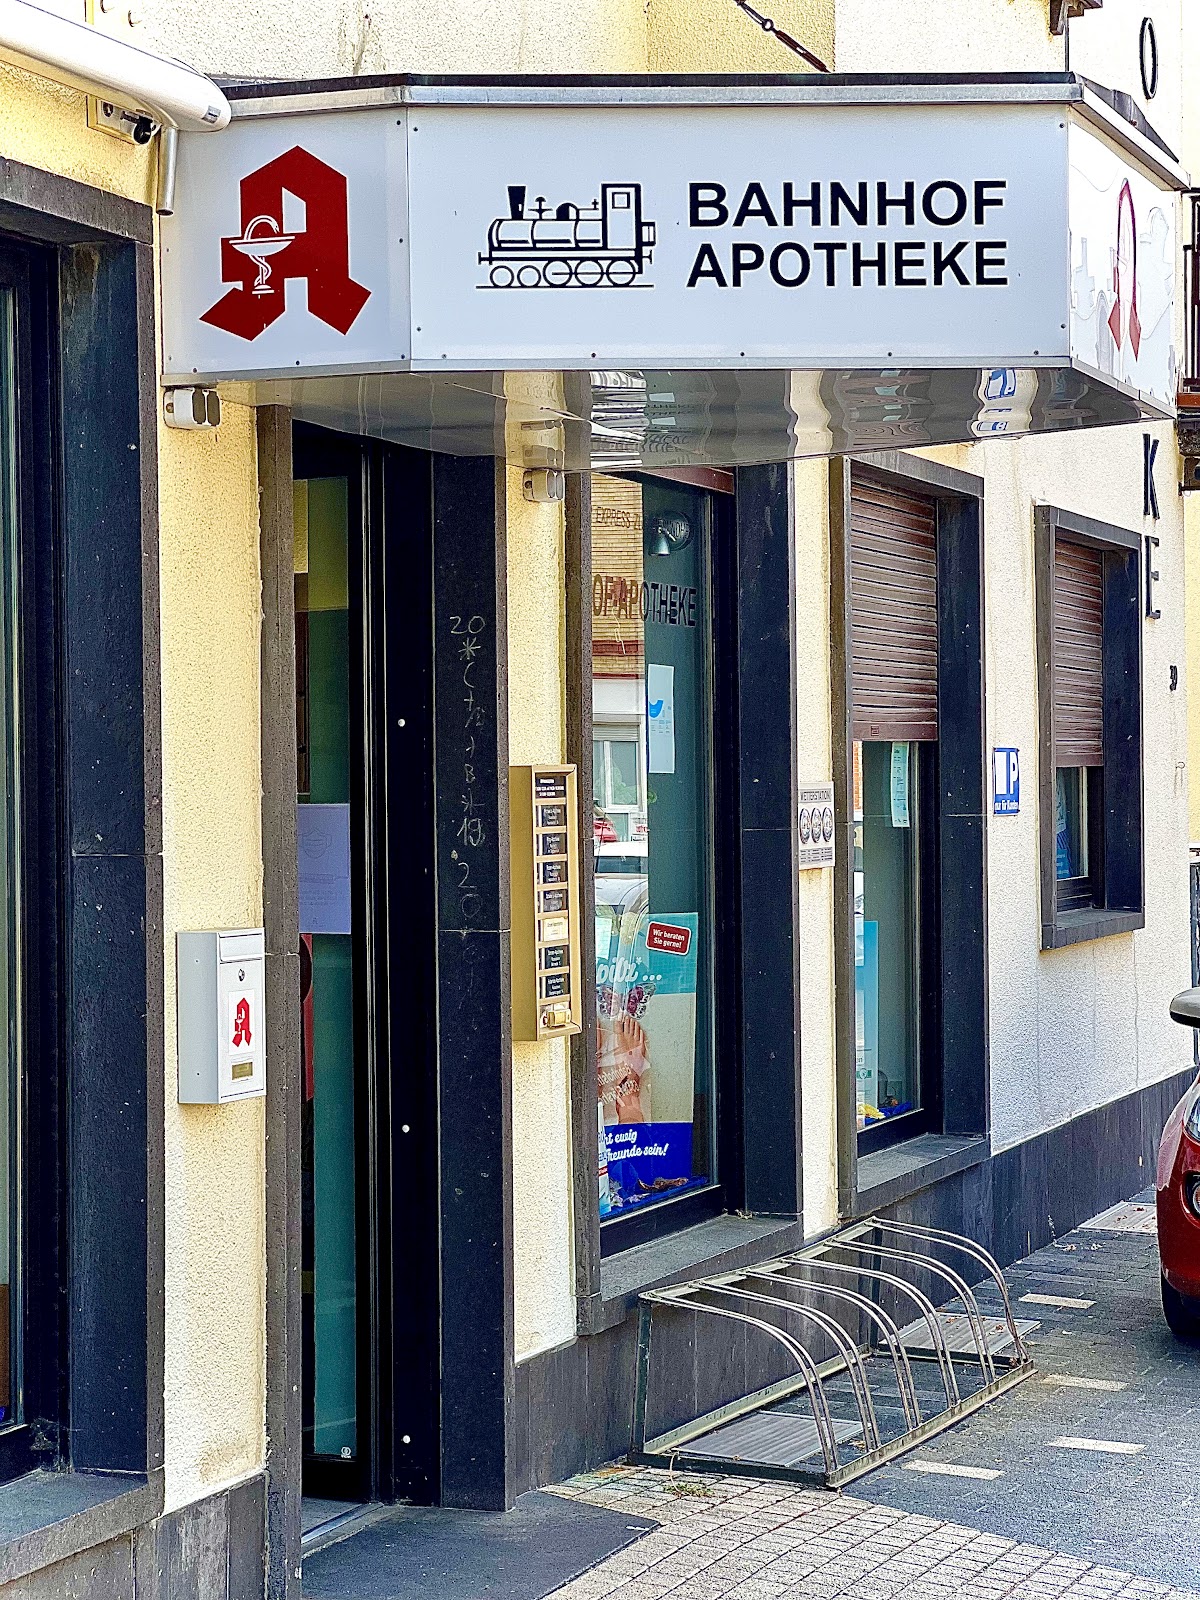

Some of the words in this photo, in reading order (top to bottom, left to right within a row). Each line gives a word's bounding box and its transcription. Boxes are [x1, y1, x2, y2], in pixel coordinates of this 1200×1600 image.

[688, 180, 1007, 227] BAHNHOF
[686, 241, 1009, 287] APOTHEKE
[450, 615, 486, 634] 20
[653, 929, 663, 937] Wir
[663, 931, 685, 942] beraten
[653, 937, 663, 945] Sie
[662, 940, 682, 949] gerne!
[614, 1128, 638, 1144] ewig
[643, 1142, 669, 1157] sein!
